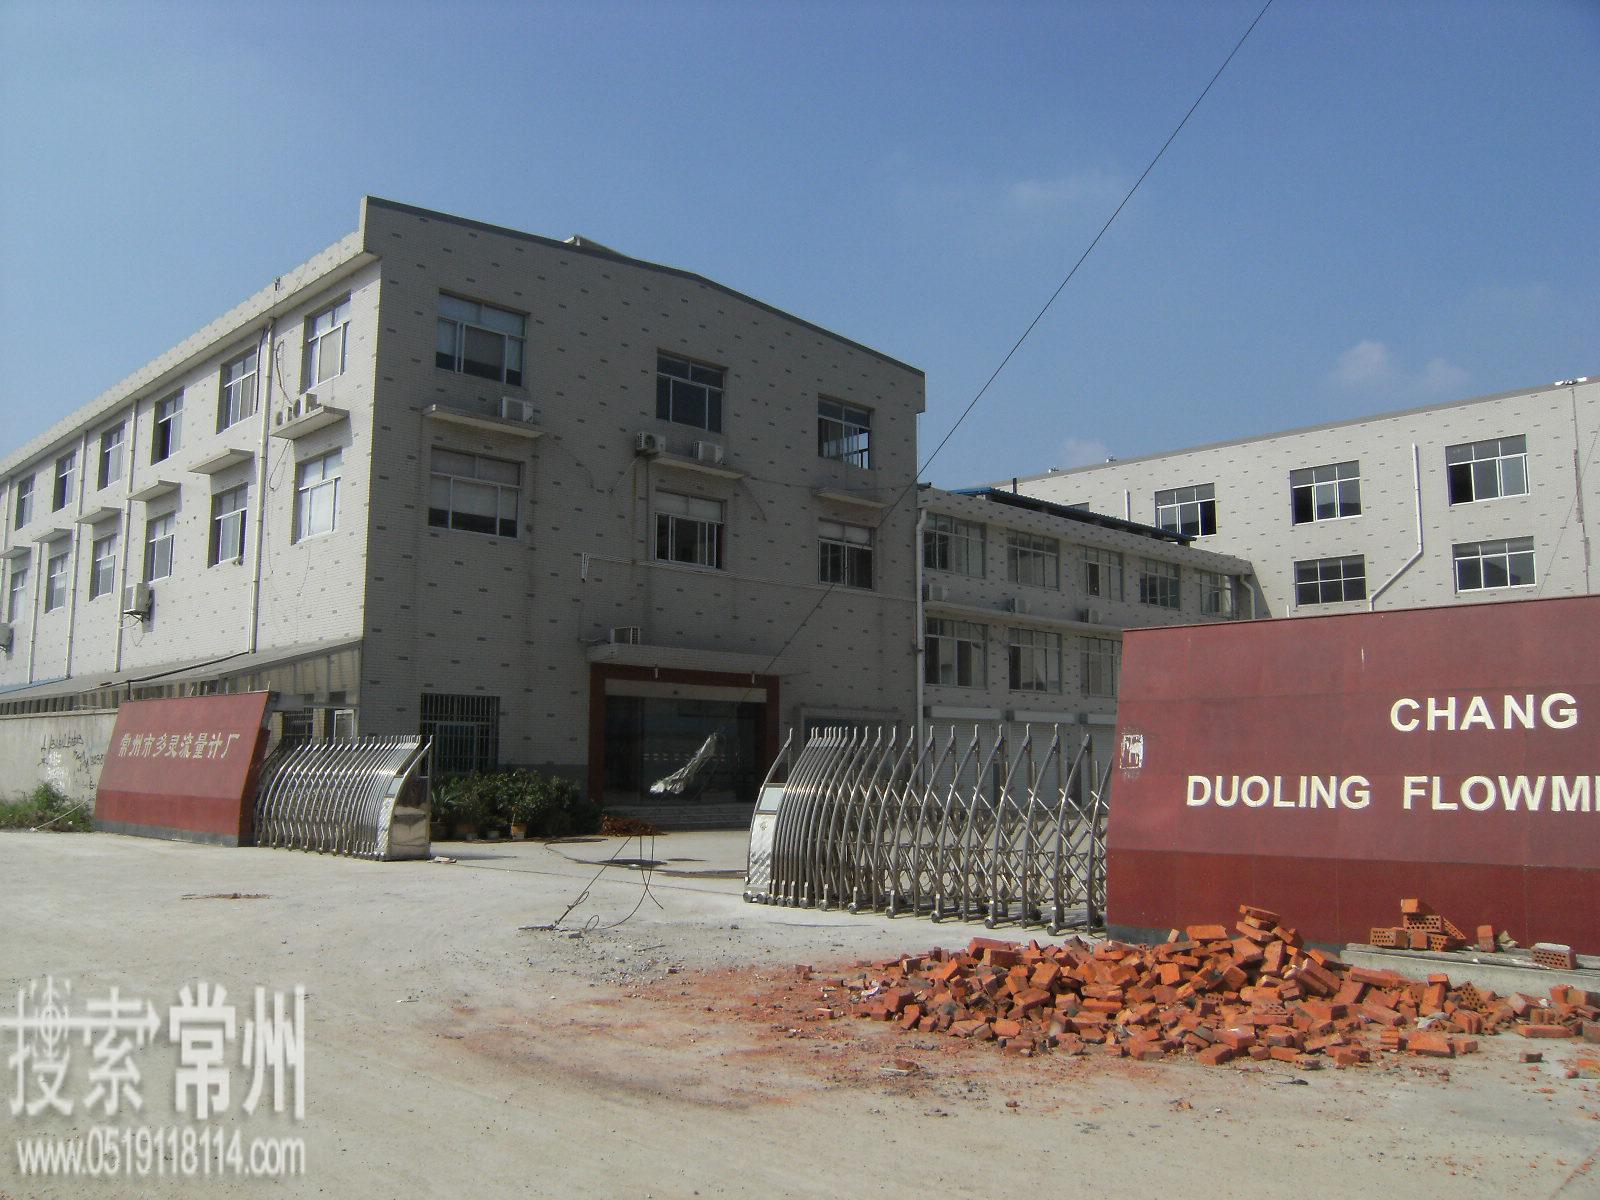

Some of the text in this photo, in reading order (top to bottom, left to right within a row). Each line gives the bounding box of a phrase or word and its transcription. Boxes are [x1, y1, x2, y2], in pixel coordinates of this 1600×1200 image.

[1390, 692, 1578, 732] CHANG
[118, 732, 240, 759] 常州市多灵流量计厂
[1186, 775, 1600, 812] DUOLING FLOWM
